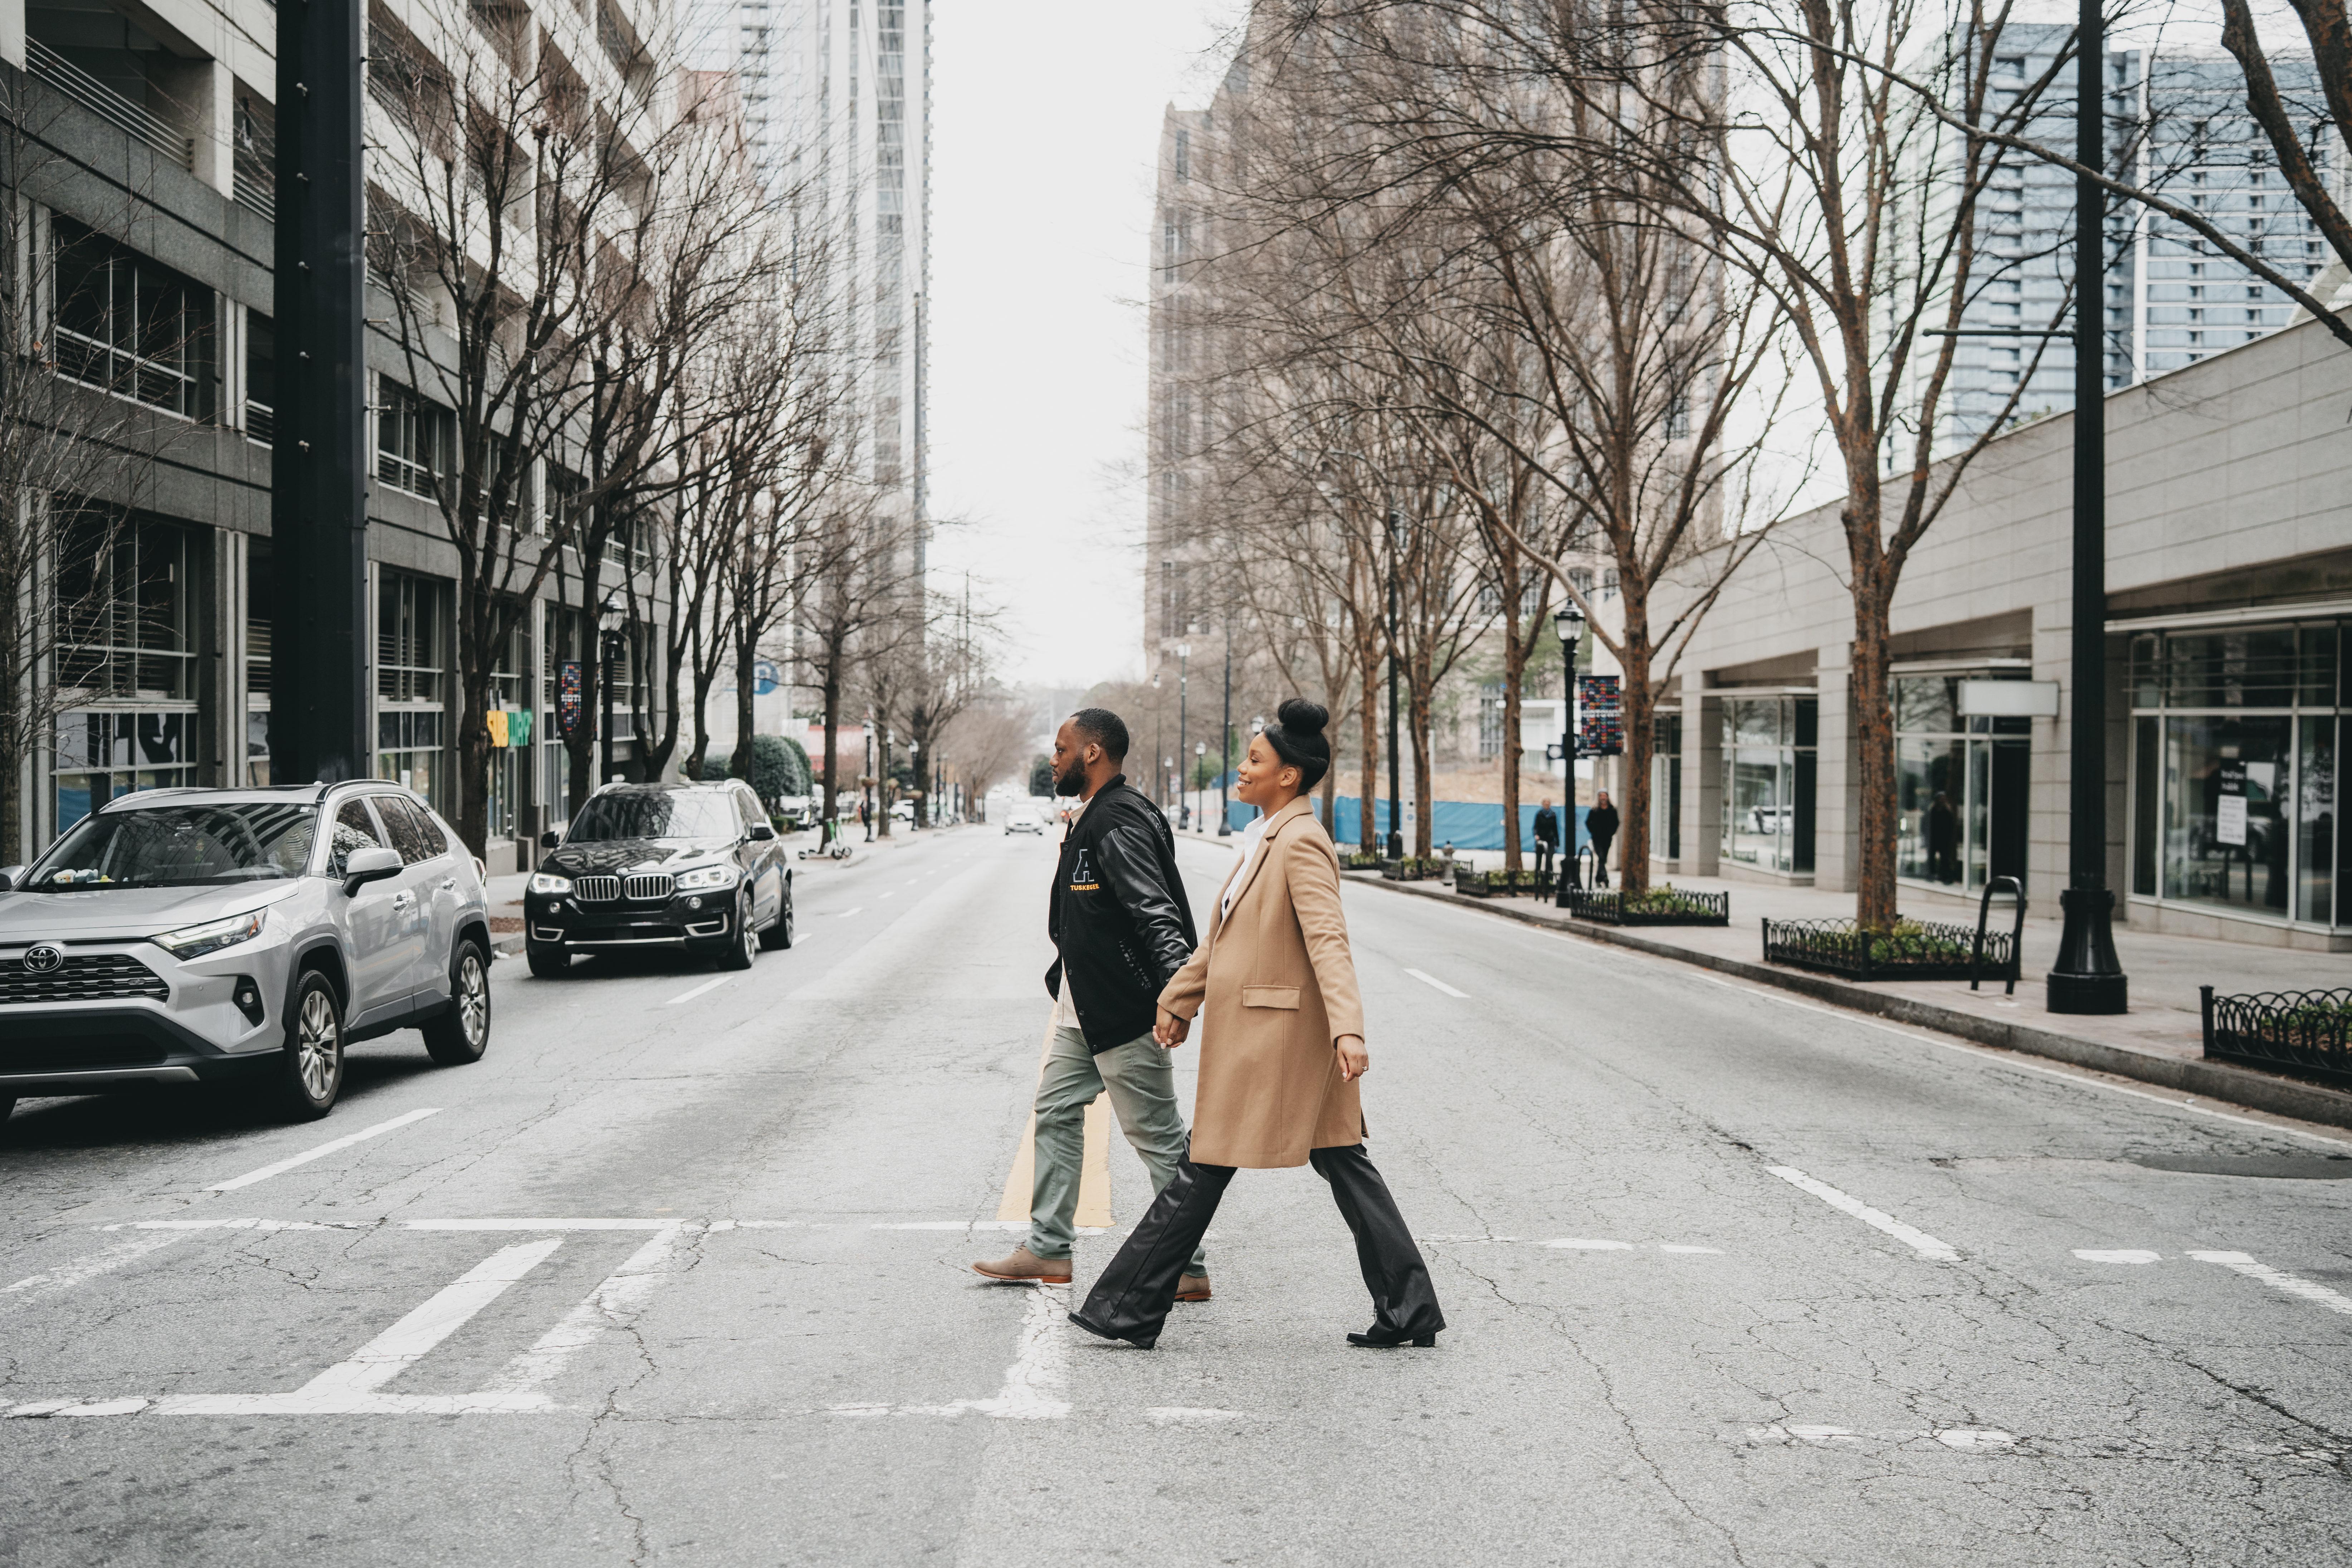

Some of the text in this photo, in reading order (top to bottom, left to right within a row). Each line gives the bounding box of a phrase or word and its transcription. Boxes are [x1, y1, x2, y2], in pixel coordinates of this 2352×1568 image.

[754, 665, 771, 691] P
[487, 710, 532, 747] SUBWAY
[1073, 849, 1094, 882] A
